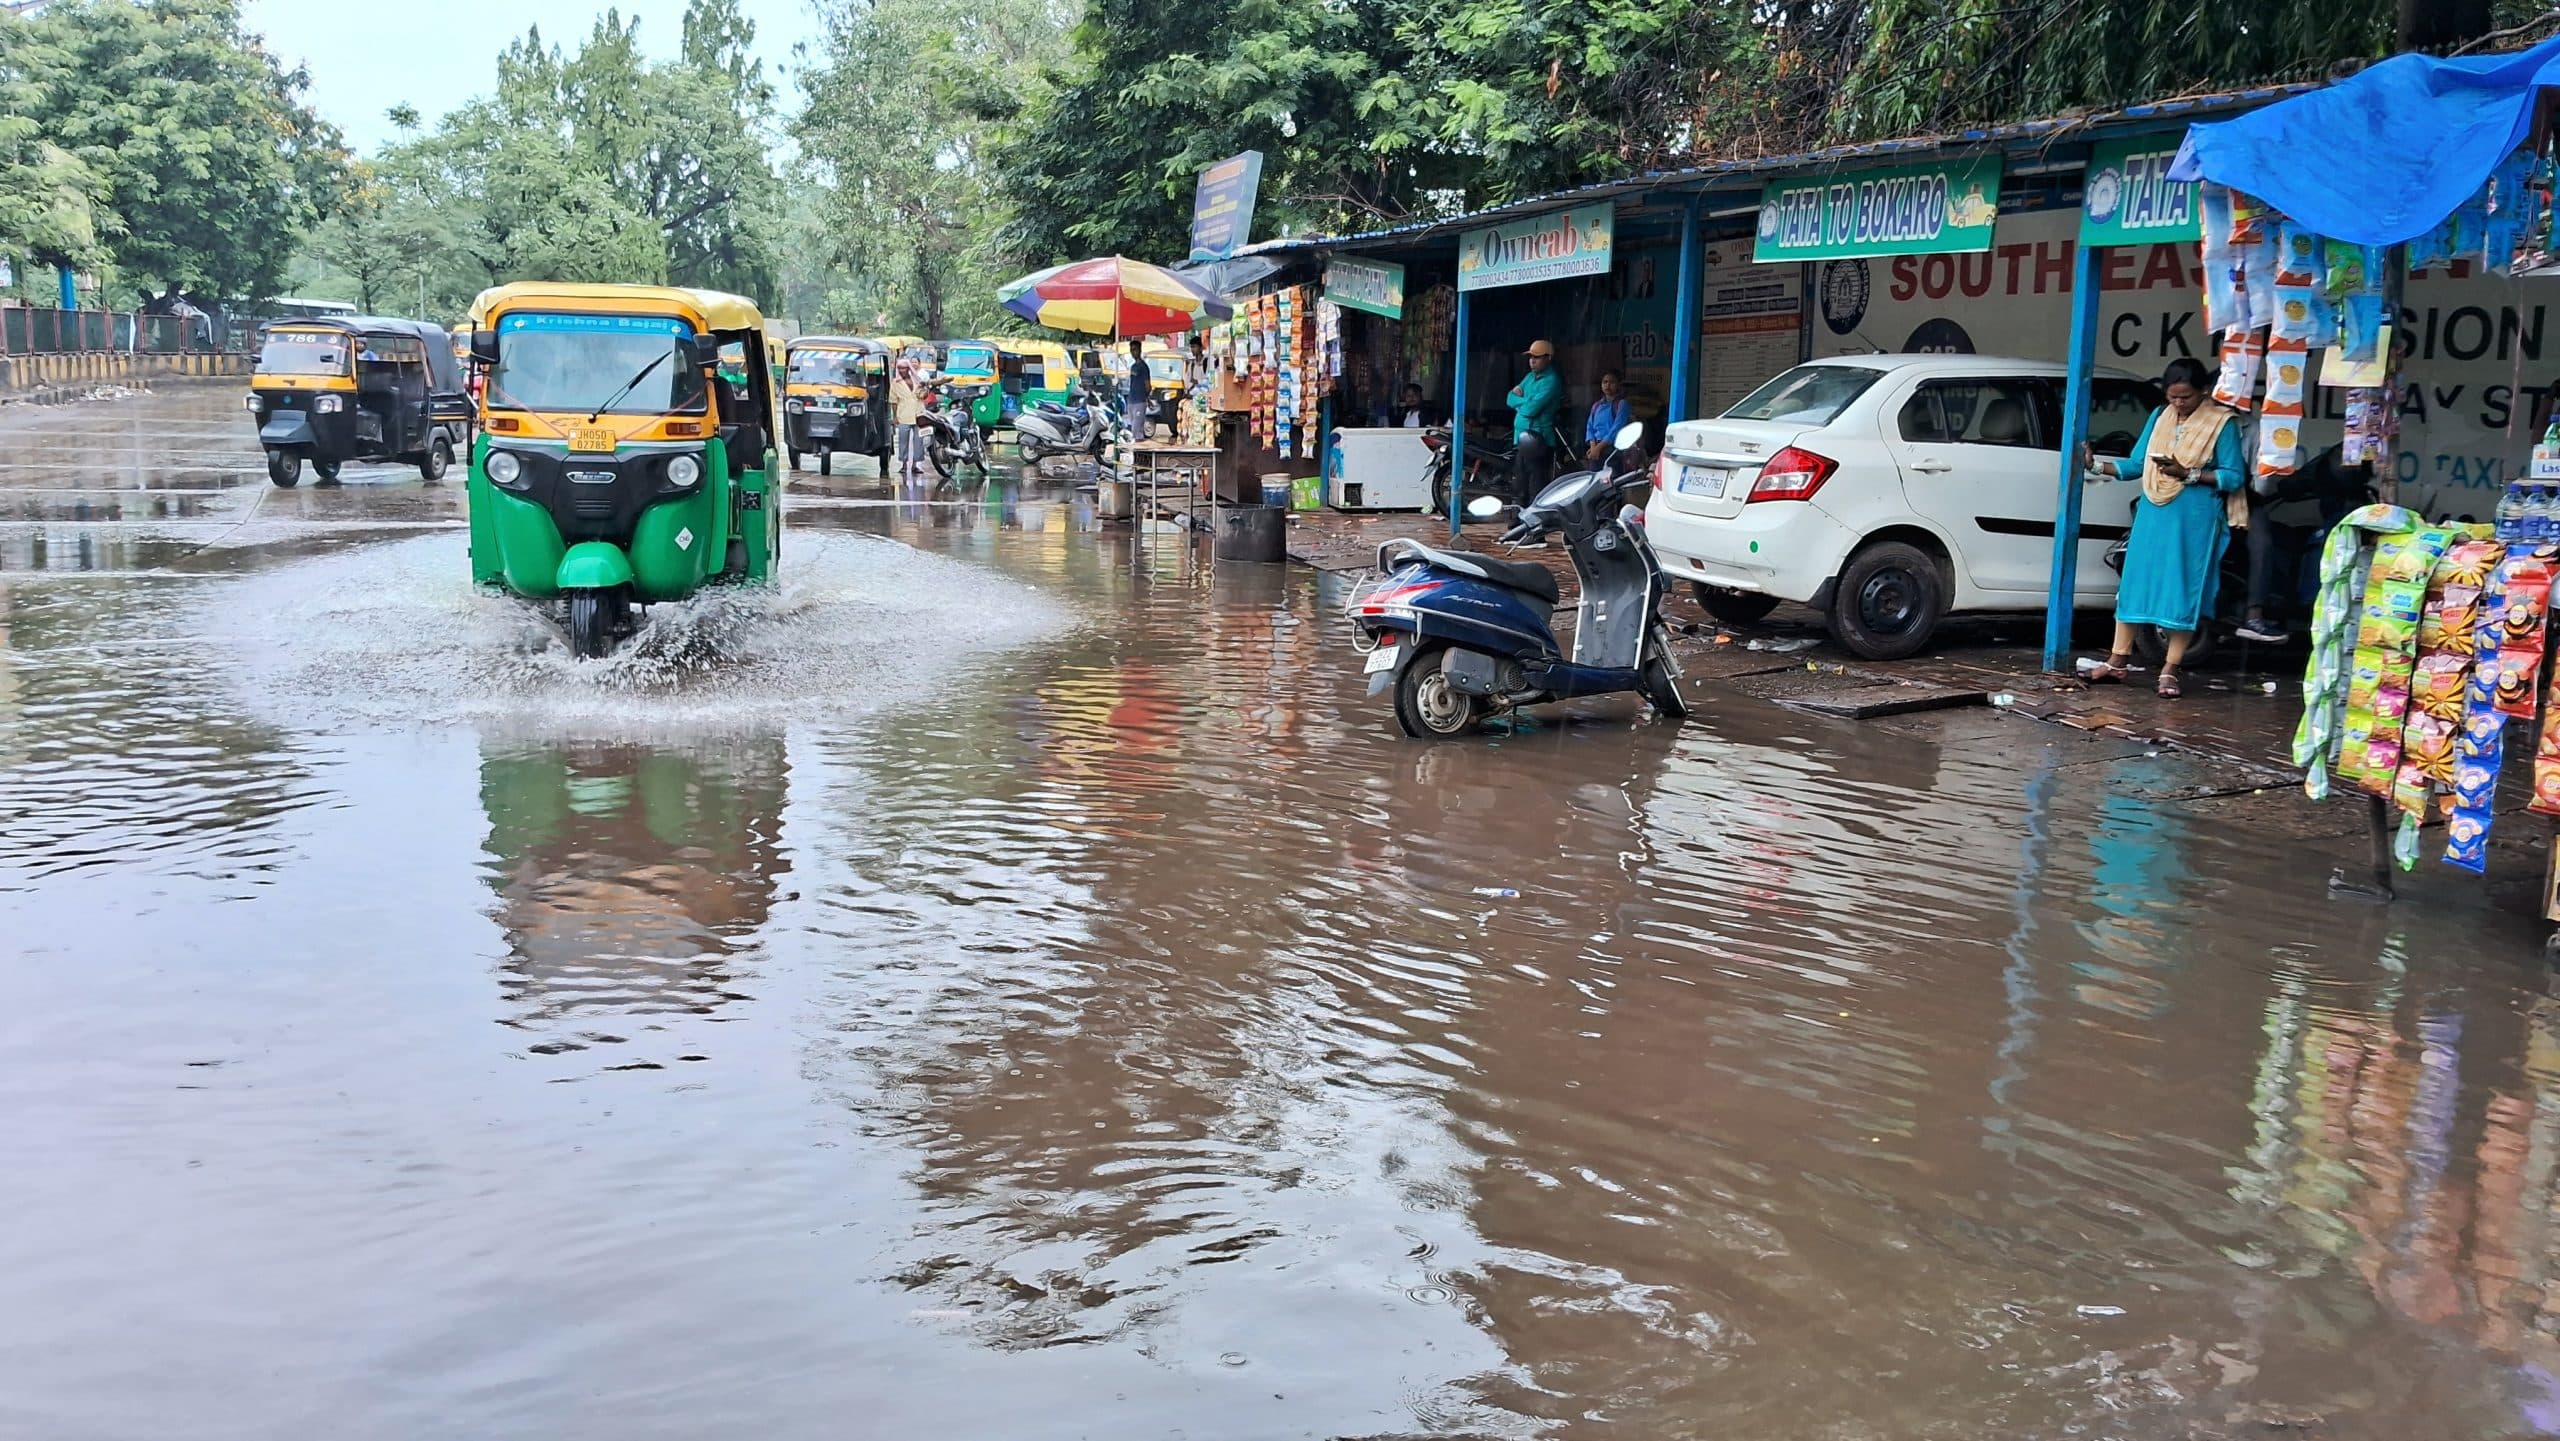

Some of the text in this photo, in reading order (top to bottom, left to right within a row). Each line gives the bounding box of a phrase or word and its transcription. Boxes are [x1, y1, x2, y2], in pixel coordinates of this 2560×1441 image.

[1779, 173, 1948, 247] TATA TO BOKARO
[1484, 214, 1578, 267] Owncab
[1890, 240, 2075, 301] SOUTH
[287, 334, 316, 344] 786
